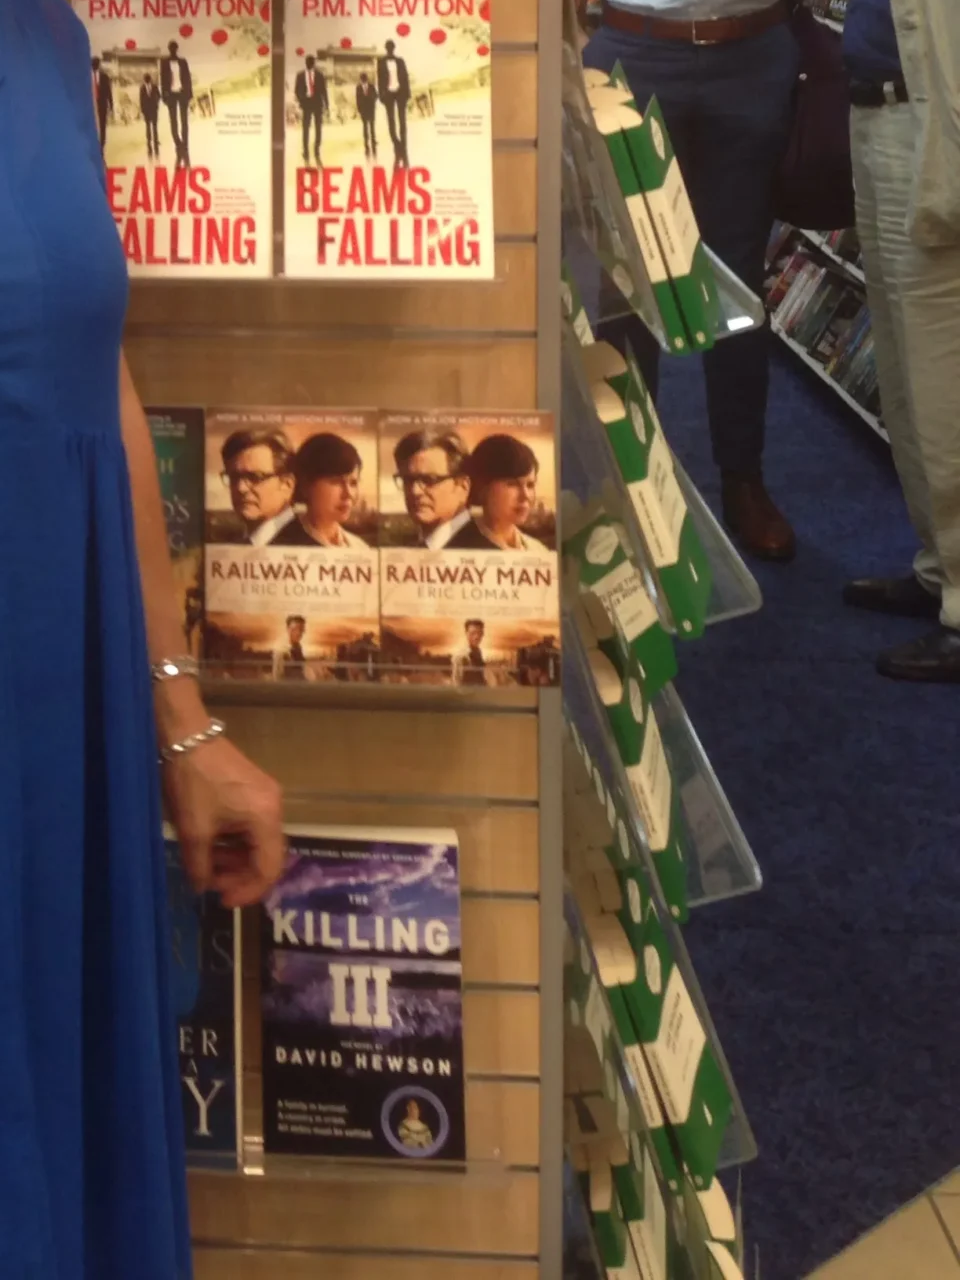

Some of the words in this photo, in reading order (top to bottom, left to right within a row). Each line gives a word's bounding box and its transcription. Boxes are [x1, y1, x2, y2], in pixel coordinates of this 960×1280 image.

[106, 166, 212, 215] EAMS
[296, 166, 432, 215] BEAMS
[317, 216, 481, 267] FALLING
[211, 560, 309, 582] RAILWAY
[318, 564, 372, 584] MAN
[386, 564, 487, 584] RAILWAY
[497, 567, 552, 587] MAN
[241, 582, 277, 596] ERIC
[284, 584, 341, 597] LOMAX
[417, 586, 454, 600] ERIC
[461, 587, 520, 601] LOMAX
[348, 893, 369, 905] THE
[273, 909, 451, 955] KILLING
[328, 963, 392, 1029] III
[275, 1045, 342, 1068] DAVID
[355, 1052, 452, 1077] HEWSON
